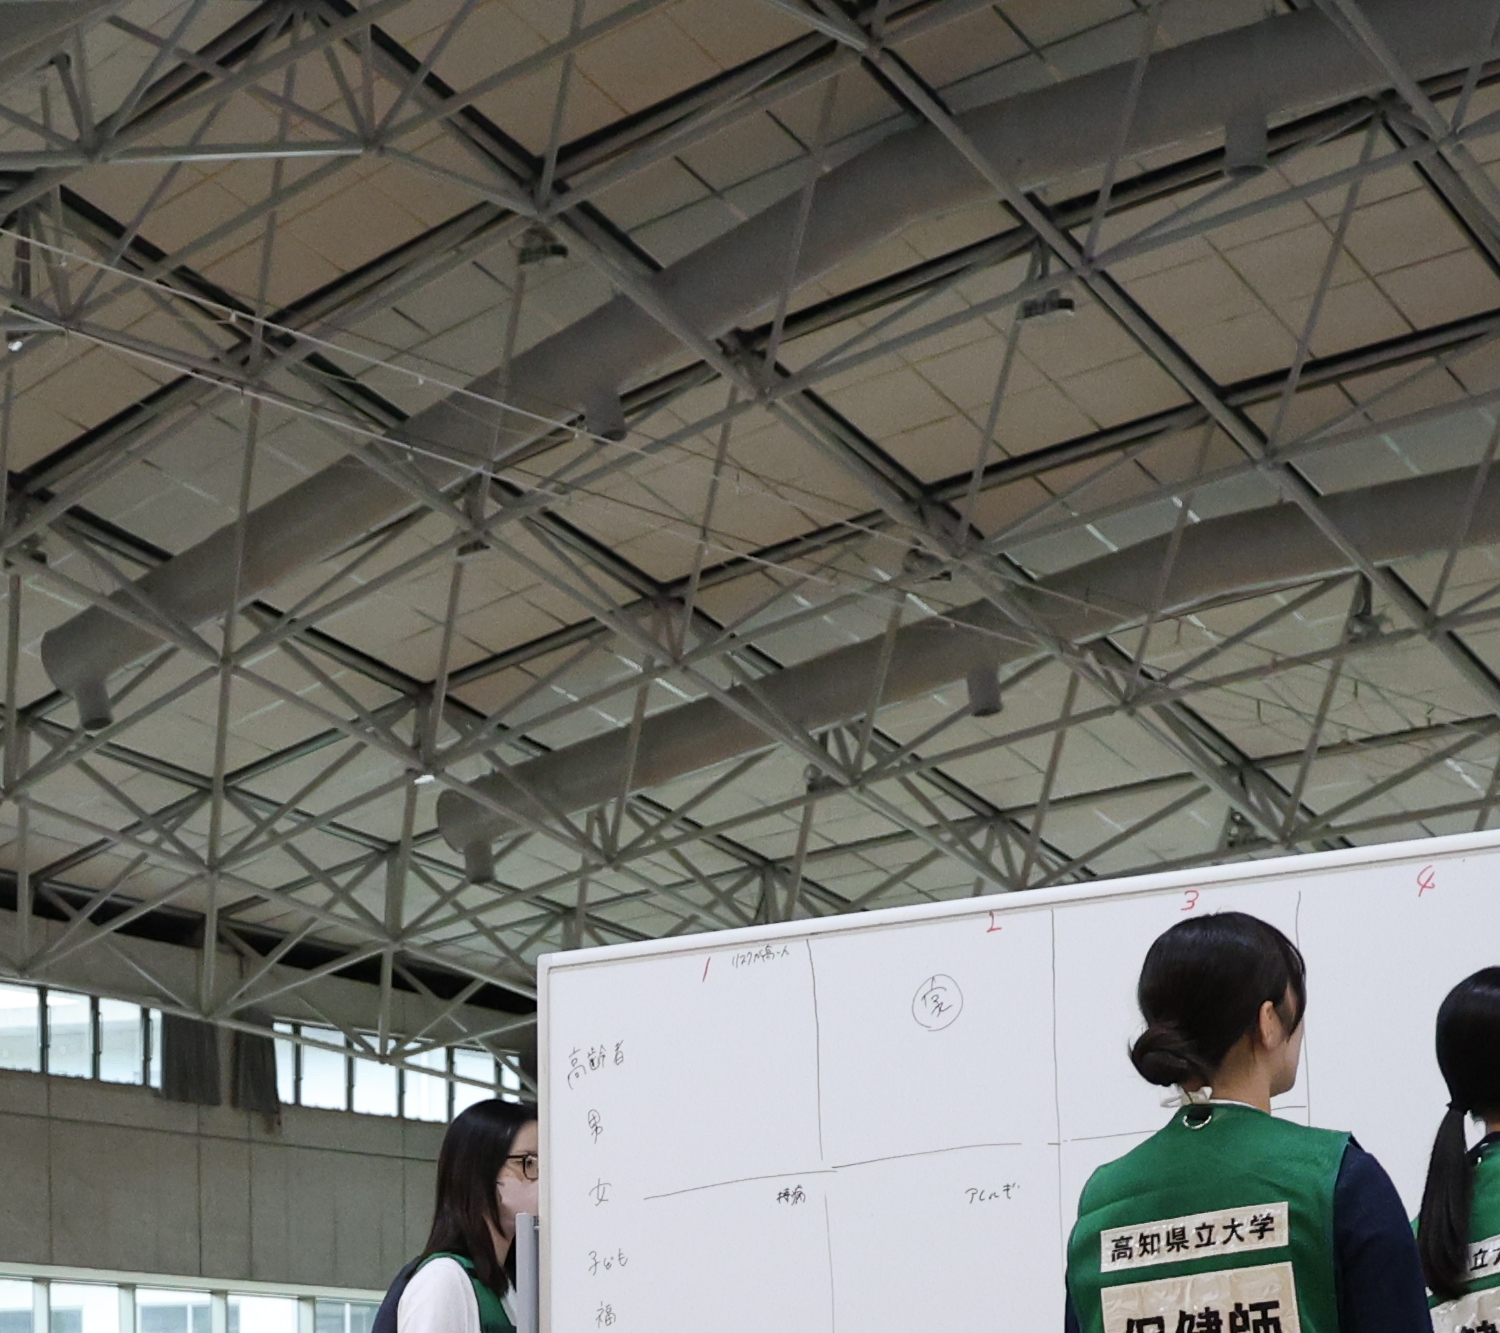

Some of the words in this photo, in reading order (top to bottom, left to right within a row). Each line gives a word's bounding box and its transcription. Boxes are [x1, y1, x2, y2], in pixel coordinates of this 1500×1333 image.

[1417, 864, 1435, 897] 4
[1180, 889, 1200, 912] 3
[986, 909, 1002, 933] 2
[567, 1040, 625, 1089] 高齢者
[587, 1109, 603, 1144] 男
[588, 1178, 612, 1206] 女
[1109, 1213, 1275, 1263] 高知県立大学
[588, 1248, 628, 1275] 子ども
